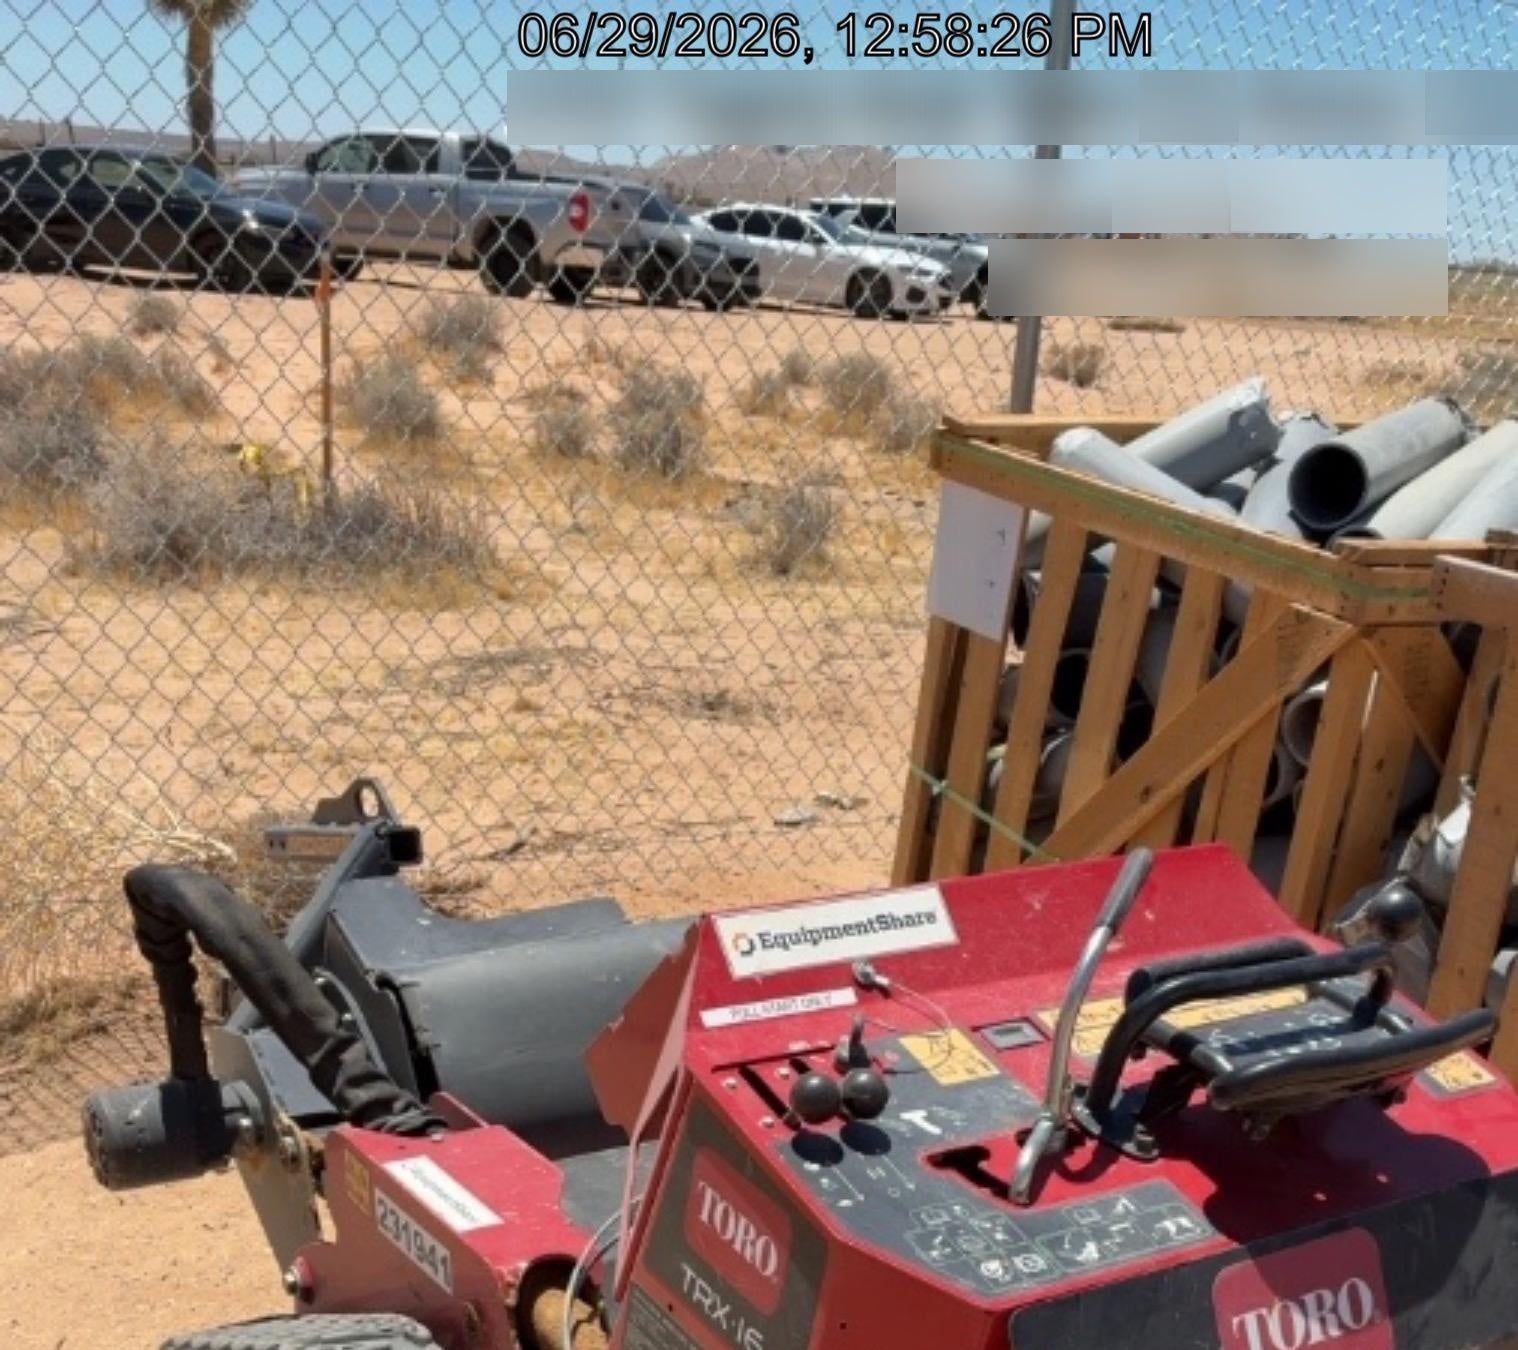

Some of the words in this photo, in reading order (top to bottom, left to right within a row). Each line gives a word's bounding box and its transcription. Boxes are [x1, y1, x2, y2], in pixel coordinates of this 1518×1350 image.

[757, 908, 938, 952] EquipmentShare
[377, 1197, 449, 1289] 231941
[698, 1181, 778, 1278] TORO
